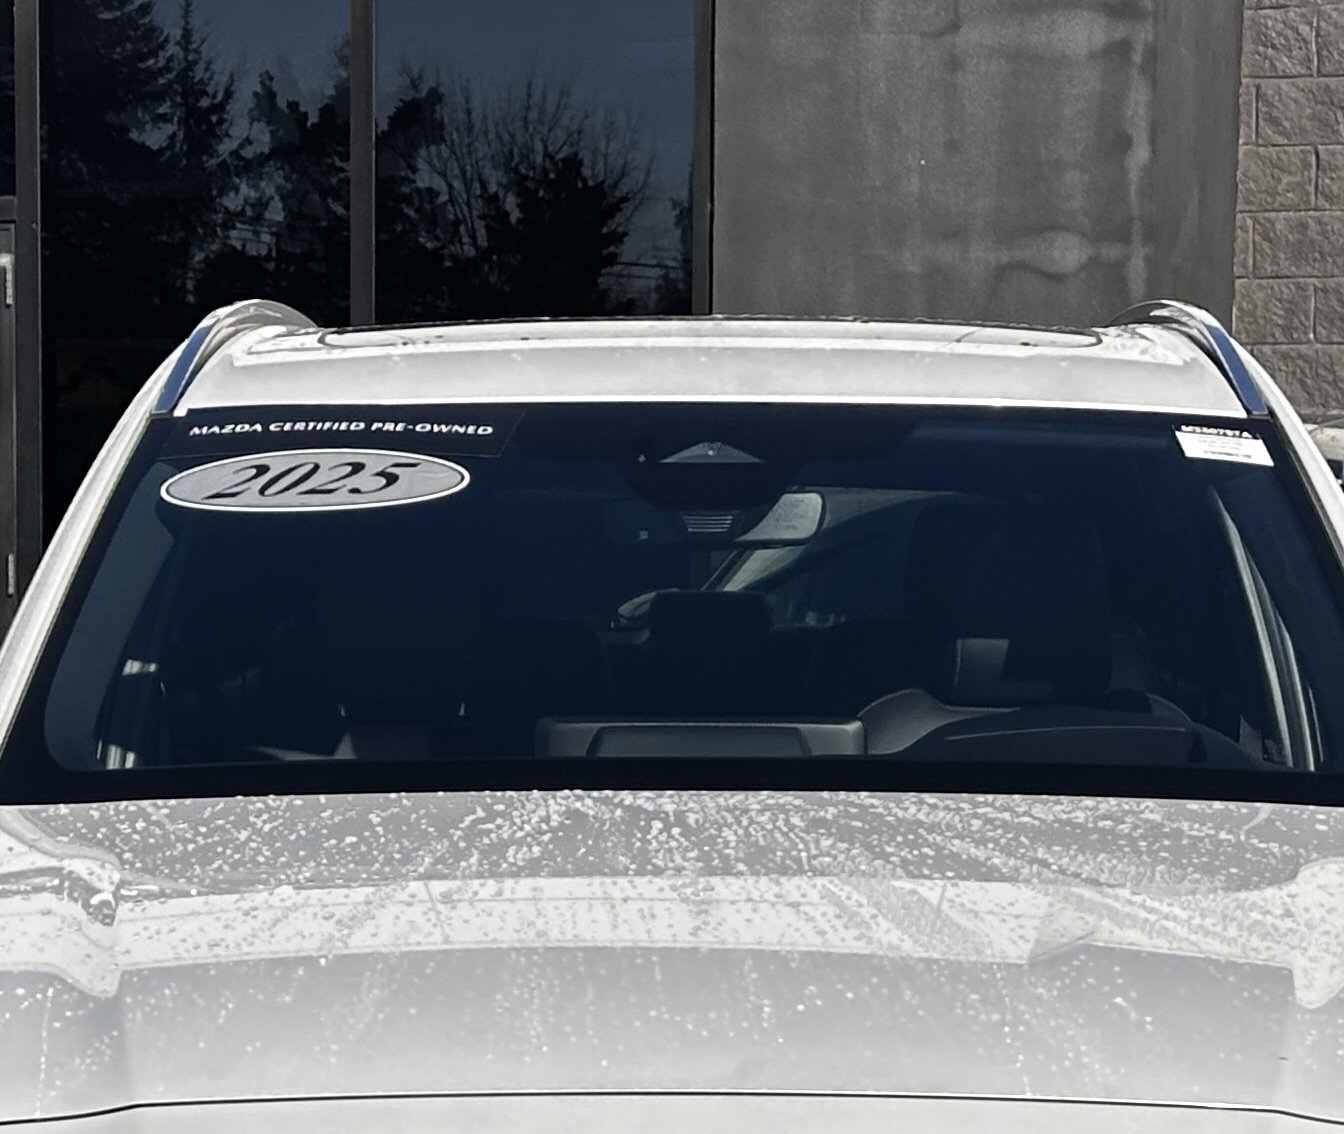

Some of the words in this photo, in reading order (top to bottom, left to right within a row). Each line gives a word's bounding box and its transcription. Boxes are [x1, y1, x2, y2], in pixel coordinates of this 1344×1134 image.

[188, 422, 263, 436] MAZDA
[269, 421, 366, 432] CERTIFIED
[370, 422, 494, 435] PRE-OWNED
[200, 461, 422, 500] 2025
